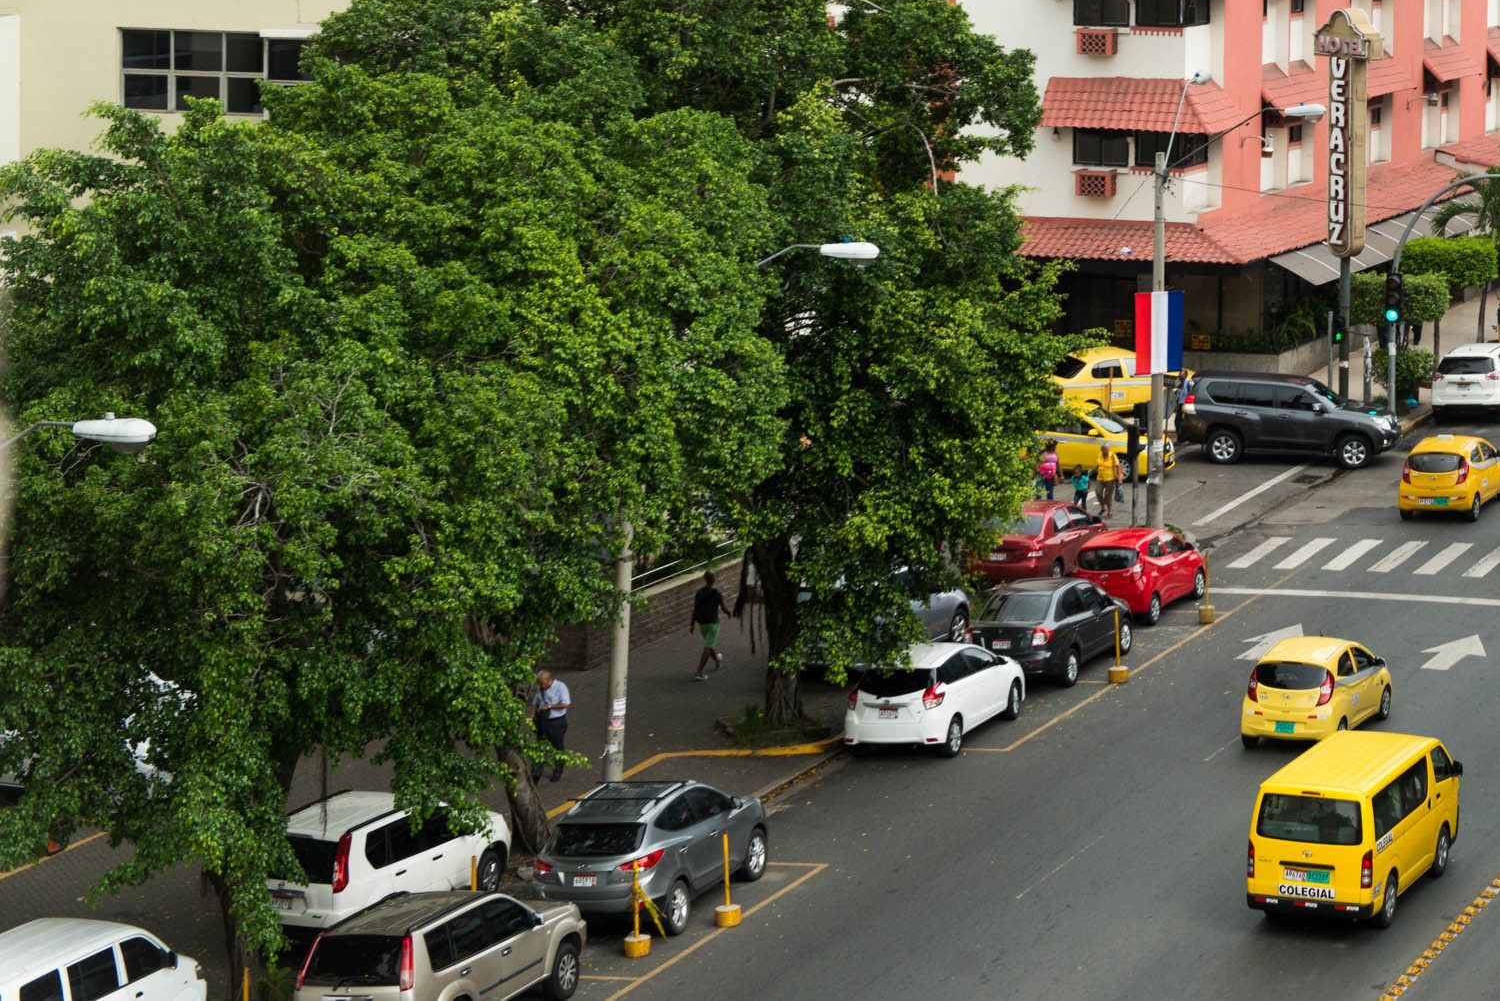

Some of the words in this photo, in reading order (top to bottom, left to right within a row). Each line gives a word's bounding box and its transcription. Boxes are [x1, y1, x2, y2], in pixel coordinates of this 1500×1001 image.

[1318, 35, 1363, 56] HOTEL
[1329, 57, 1345, 244] VERACRUZ
[1278, 884, 1335, 899] COLEGIAL
